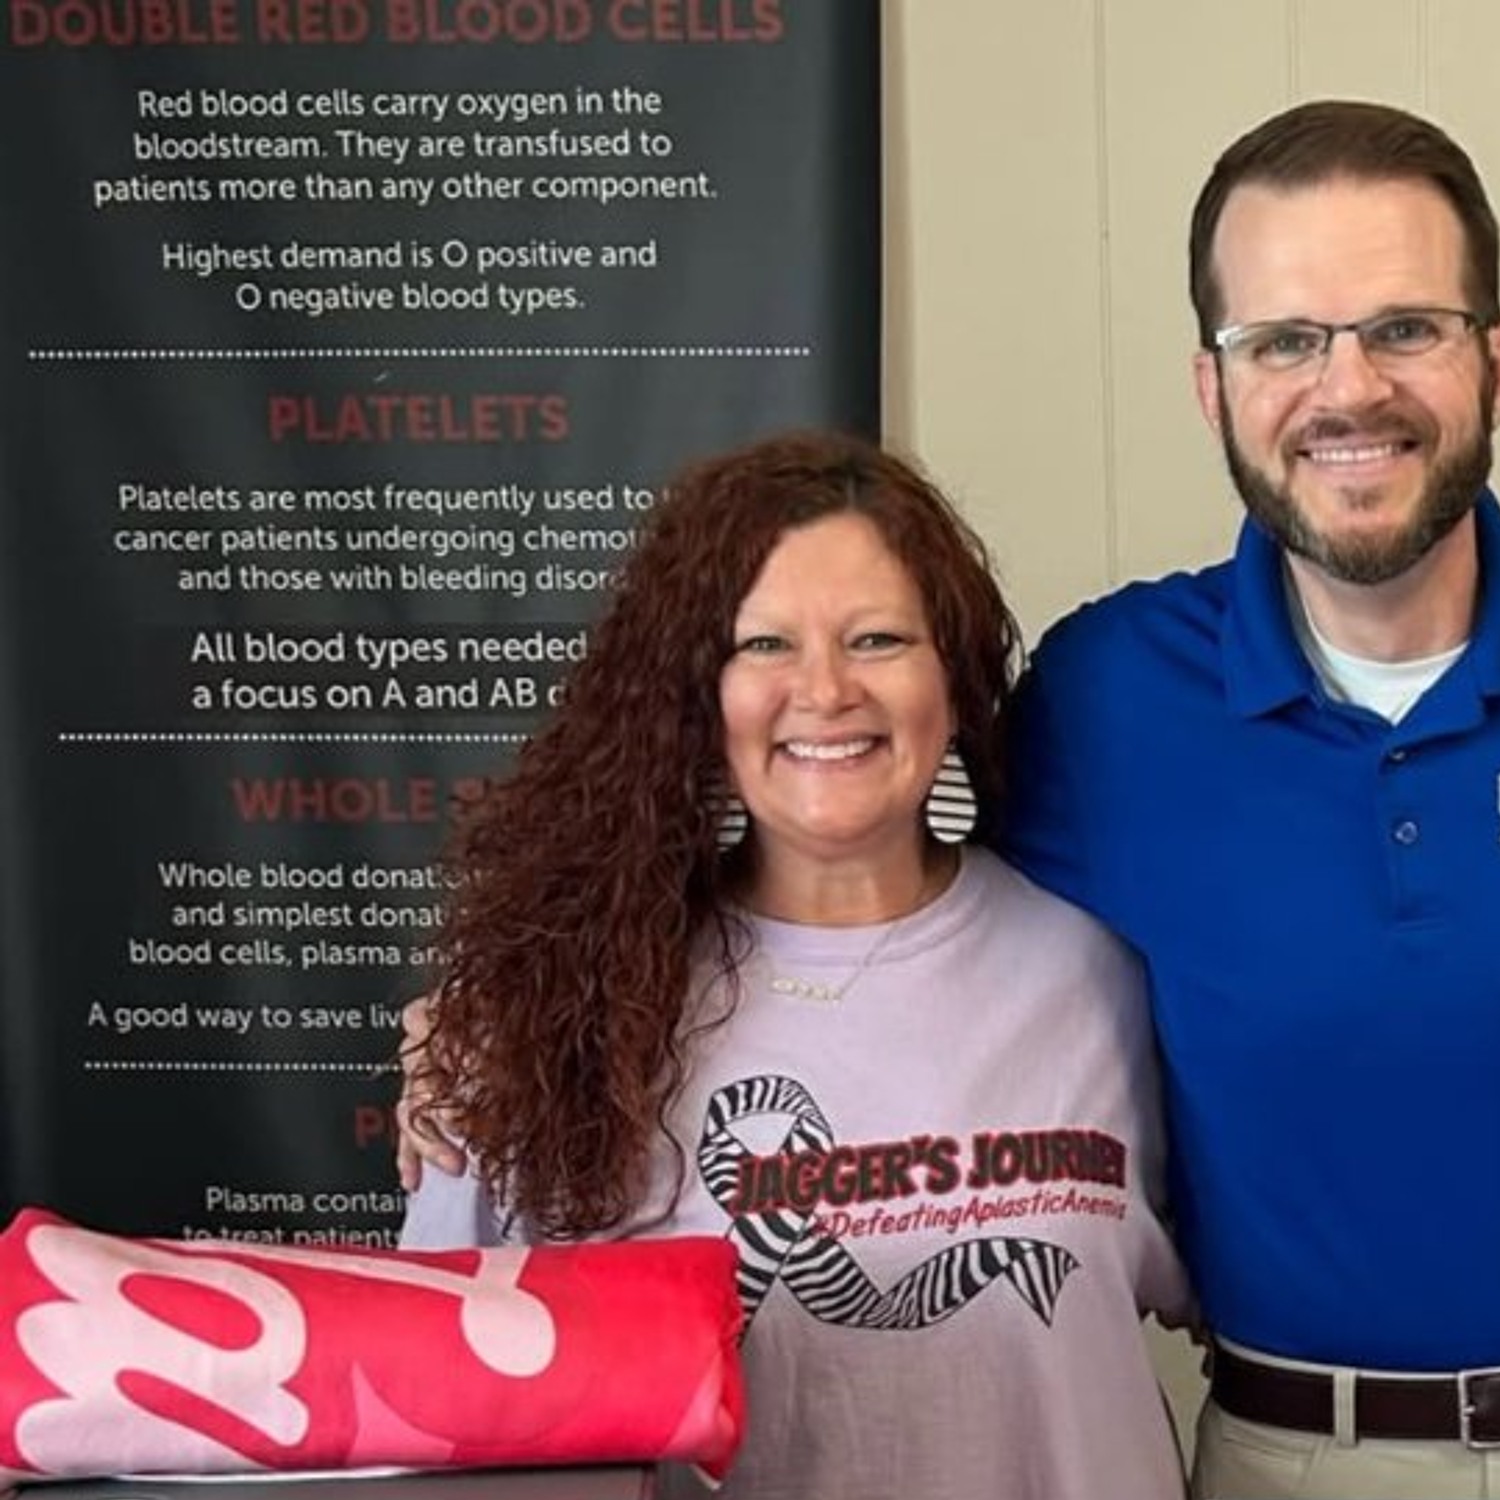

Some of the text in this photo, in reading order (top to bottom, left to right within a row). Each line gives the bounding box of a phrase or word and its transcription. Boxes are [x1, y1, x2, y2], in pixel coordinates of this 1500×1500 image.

[11, 0, 784, 45] DOUBLE RED BLOOD CELLS
[139, 87, 662, 122] Red blood cells carry oxygen in the
[134, 129, 673, 164] bloodstream. They are transfused to
[94, 173, 718, 207] patients more than any other component.
[162, 240, 657, 277] Highest demand is O positive and
[236, 283, 585, 317] O negative blood types.
[268, 396, 570, 443] PLATELETS
[119, 485, 241, 511] Platelets
[250, 491, 295, 510] are
[305, 487, 376, 511] most
[384, 484, 536, 516] frequently
[543, 486, 614, 510] used
[622, 486, 654, 510] to
[114, 530, 212, 551] cancer
[221, 524, 338, 555] patients
[346, 525, 515, 556] undergoing
[178, 565, 231, 590] and
[239, 564, 322, 590] those
[330, 564, 393, 590] with
[401, 564, 526, 597] bleeding
[190, 631, 588, 669] All blood types needed
[193, 684, 212, 709] a
[221, 679, 318, 708] focus
[326, 685, 373, 708] on
[383, 678, 407, 707] A
[416, 679, 479, 707] and
[489, 678, 538, 707] AB
[232, 777, 437, 823] WHOLE
[158, 863, 252, 889] Whole
[260, 862, 343, 889] blood
[172, 902, 450, 930] and simplest donat
[129, 940, 213, 965] blood
[219, 940, 293, 968] cells,
[302, 940, 400, 969] plasma
[88, 1001, 402, 1033] A good way to save liv
[732, 1135, 961, 1216] JAGGER'S
[206, 1186, 405, 1212] Plasma contai
